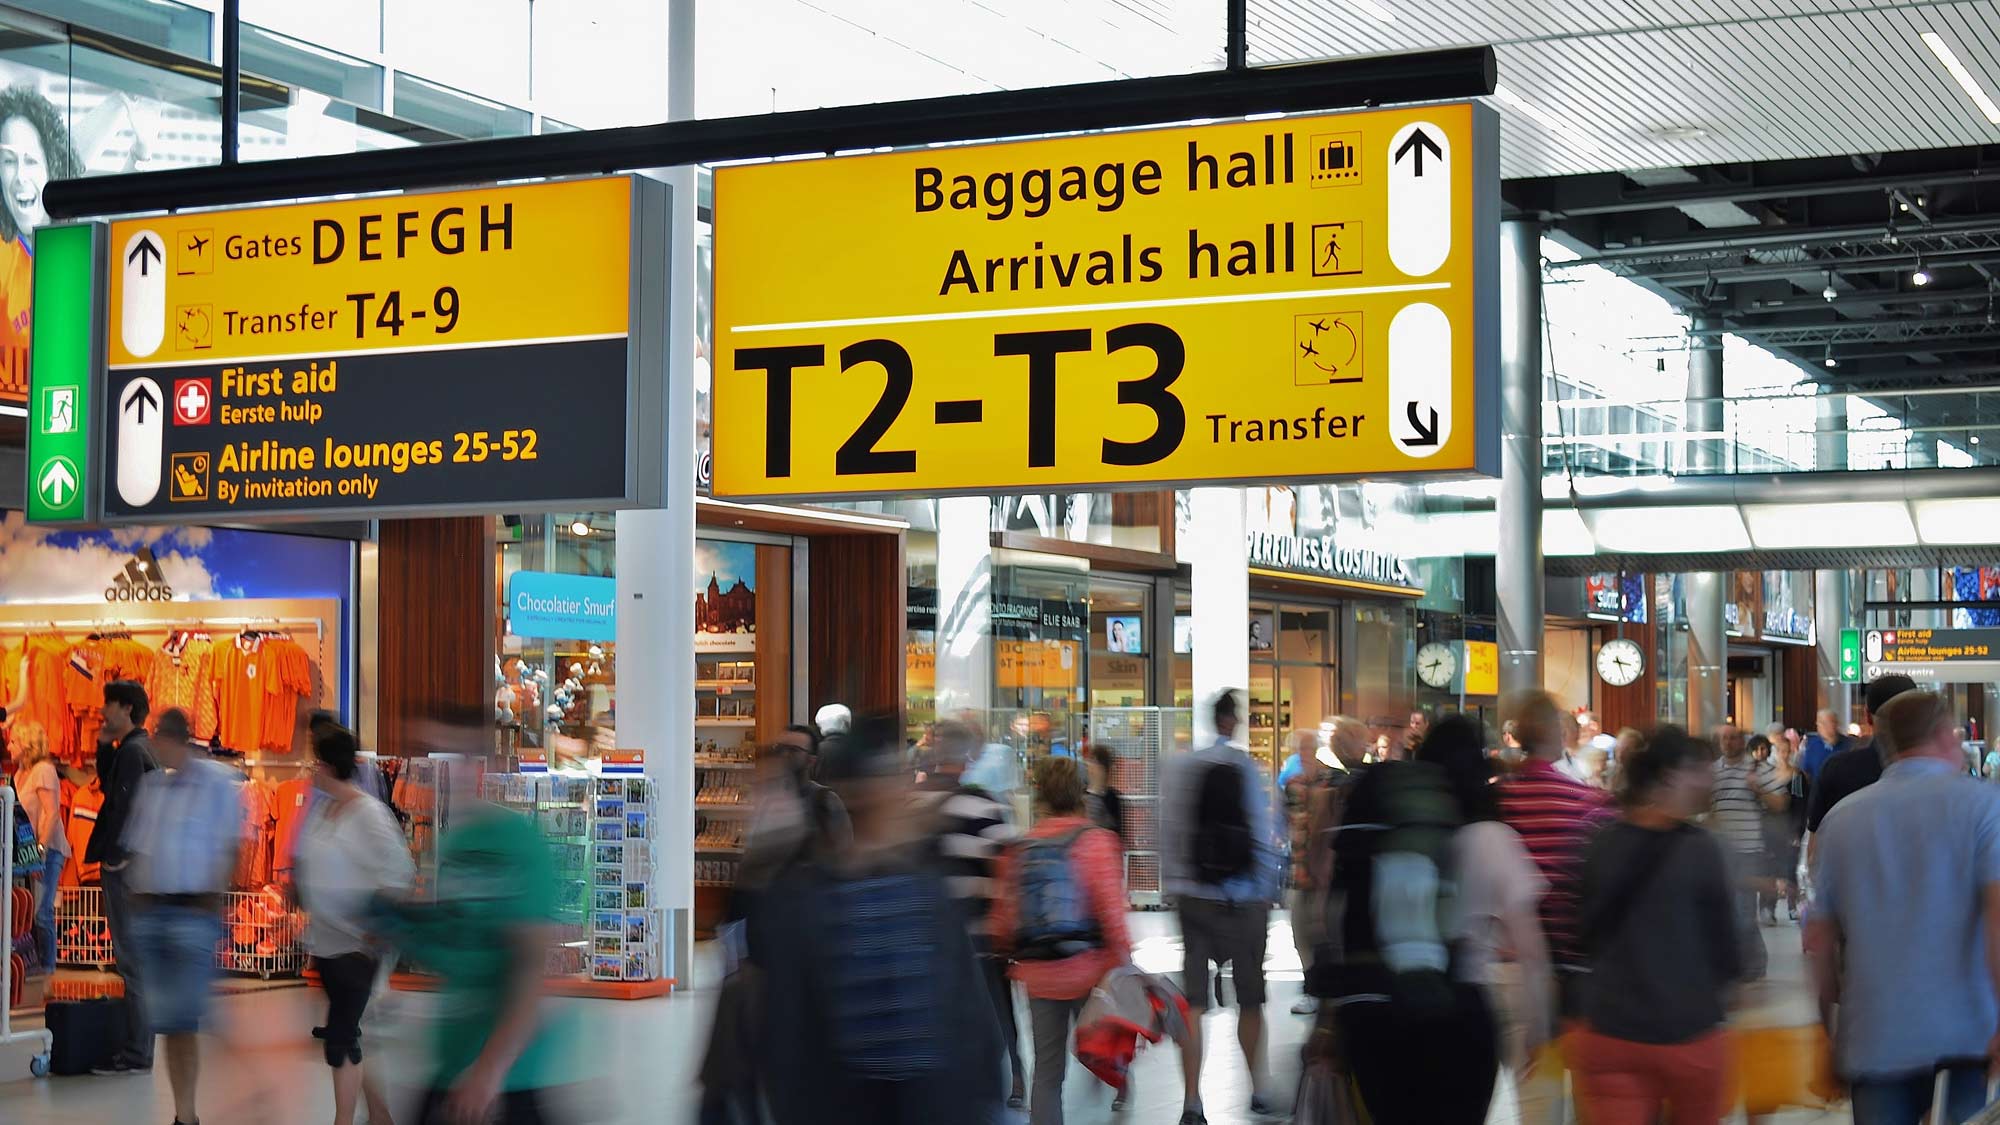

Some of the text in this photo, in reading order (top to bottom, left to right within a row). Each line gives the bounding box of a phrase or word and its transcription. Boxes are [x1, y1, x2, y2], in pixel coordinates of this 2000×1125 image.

[915, 133, 1294, 221] Baggage hall
[225, 235, 302, 260] Gates
[939, 222, 1294, 296] Arrivals hall
[223, 286, 460, 339] Transfer T4-9
[221, 361, 337, 398] First aid
[220, 400, 323, 425] Eerste hulp
[733, 322, 1365, 479] T2-T3 Transfer
[218, 429, 538, 474] Airline lounges 25-52
[217, 473, 379, 505] By invitation only
[1321, 535, 1332, 570] &
[1335, 548, 1406, 581] COSMETICS
[105, 581, 172, 602] adidas
[517, 591, 615, 616] Chocolatier Smurf
[1043, 613, 1081, 629] ELIE SAAB
[1897, 629, 1932, 639] First aid
[1907, 667, 1934, 677] centre
